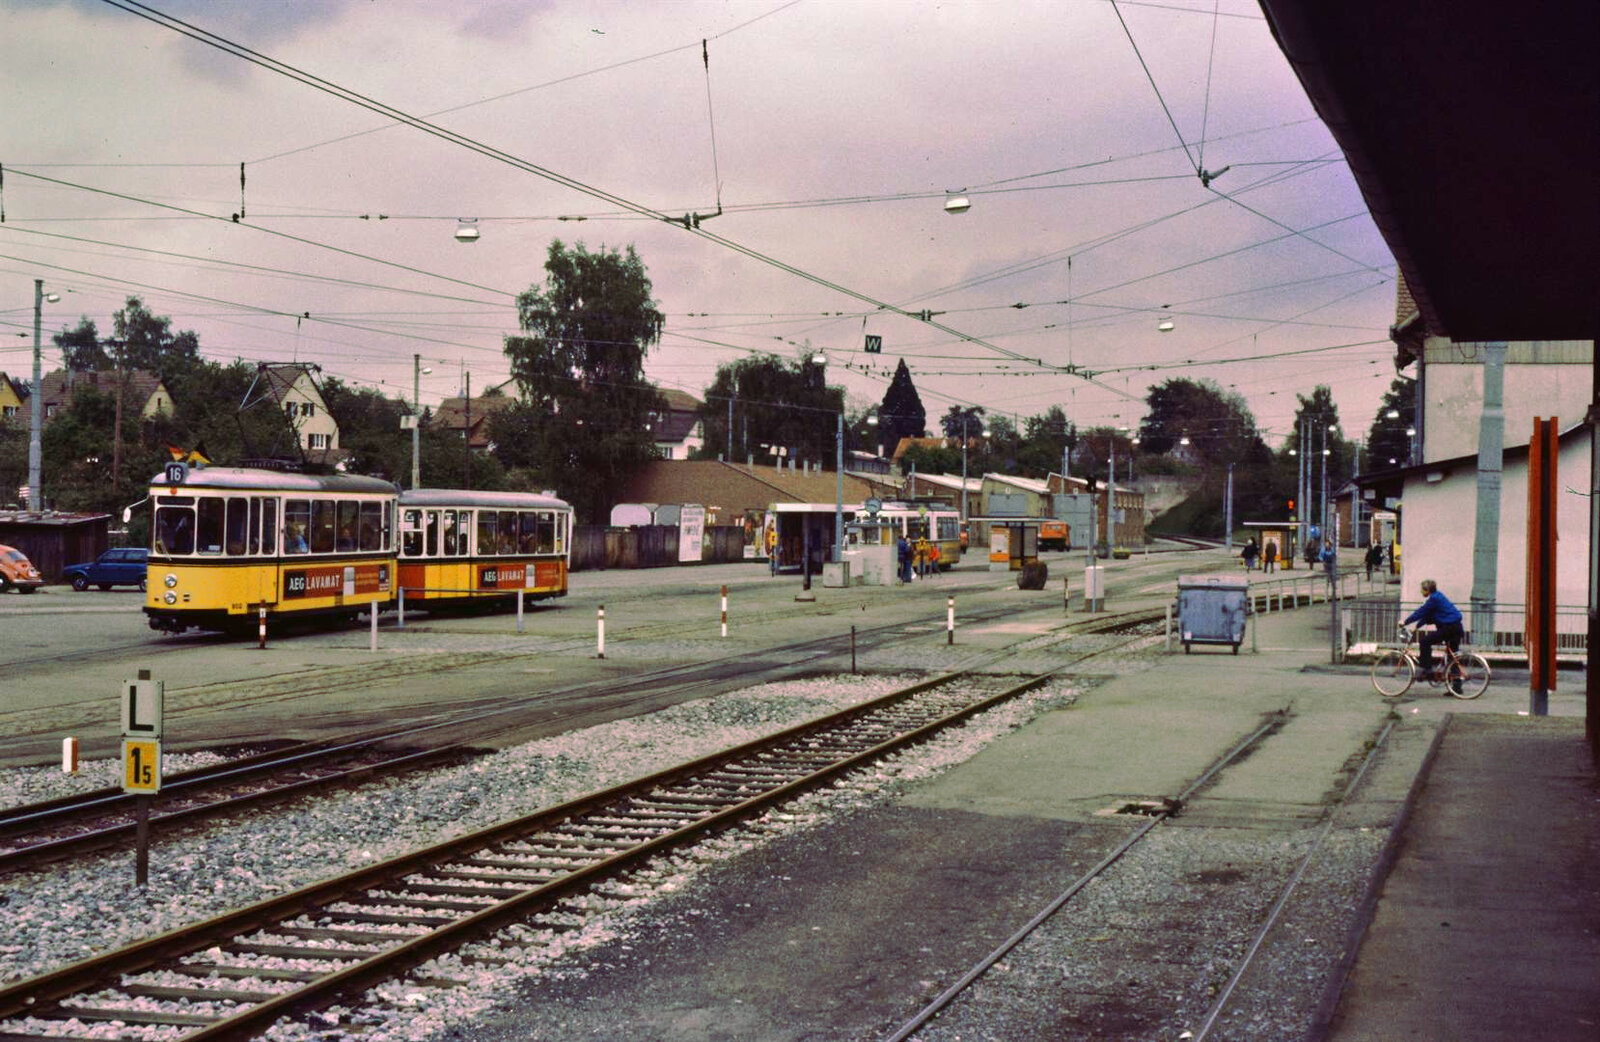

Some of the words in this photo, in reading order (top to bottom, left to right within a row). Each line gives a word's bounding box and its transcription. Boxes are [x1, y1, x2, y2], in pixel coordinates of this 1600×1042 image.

[867, 337, 881, 351] W
[170, 467, 181, 481] 16
[288, 576, 305, 591] AEG
[306, 574, 340, 590] LAVAMAT
[483, 570, 496, 582] AEG
[497, 569, 525, 581] LAVAMAT
[129, 685, 154, 731] L
